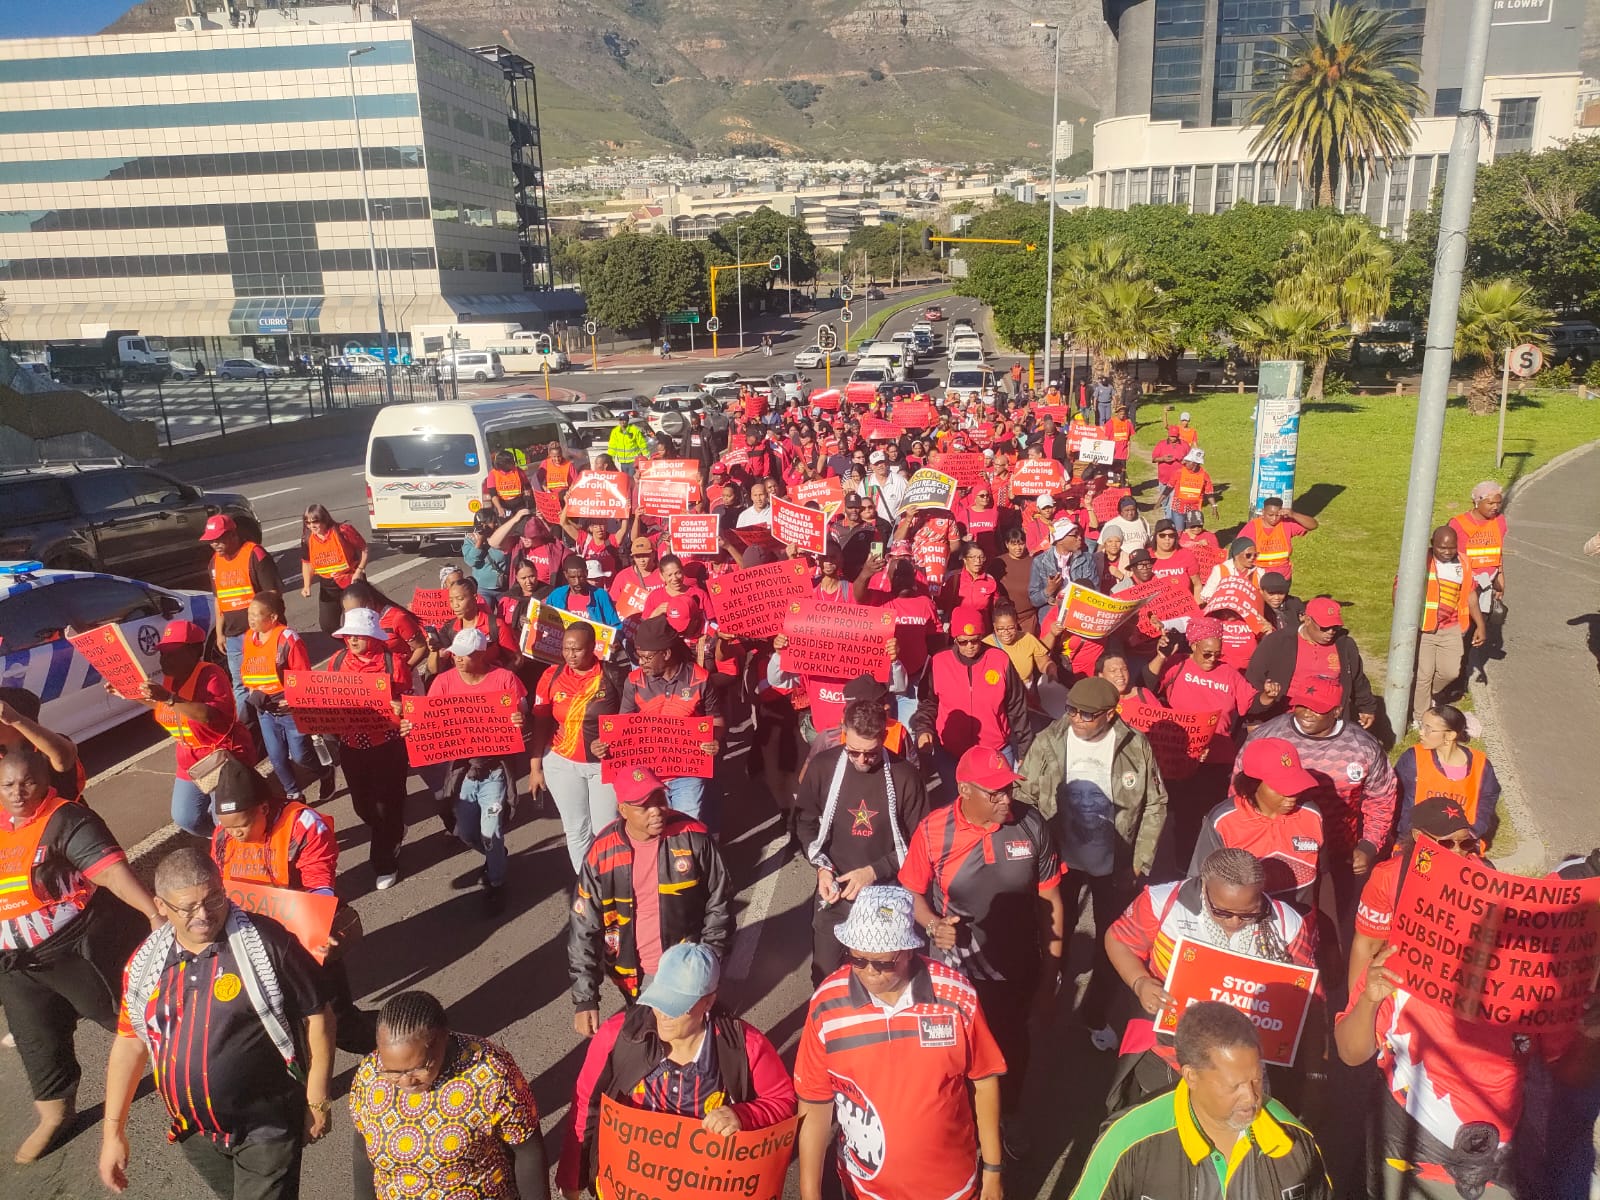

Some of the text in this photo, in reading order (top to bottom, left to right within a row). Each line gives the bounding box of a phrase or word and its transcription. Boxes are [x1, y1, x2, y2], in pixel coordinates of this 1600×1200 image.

[1507, 0, 1545, 9] LOWRY
[259, 318, 287, 326] CURRO
[1520, 352, 1533, 368] S
[581, 472, 617, 480] Labour
[797, 482, 828, 492] Labour
[1022, 487, 1051, 495] Slavery
[797, 489, 831, 500] Broking
[568, 498, 626, 509] Modern Day
[579, 507, 616, 518] Slavery
[780, 507, 811, 521] COSATU
[773, 516, 820, 536] DEPENDABLE
[778, 511, 814, 529] DEMANDS
[780, 526, 810, 540] ENERGY
[780, 532, 811, 547] SUPPLY!
[921, 545, 945, 553] bour
[924, 554, 945, 565] king
[733, 565, 783, 583] COMPANIES
[1152, 568, 1184, 577] ACTWU
[730, 576, 792, 596] MUST PROVIDE
[1130, 580, 1164, 596] COMPANIES
[1220, 576, 1256, 591] abour
[723, 597, 746, 611] SAFE,
[748, 589, 784, 607] RELIABLE
[786, 585, 804, 595] AND
[1087, 596, 1105, 606] COST
[719, 605, 765, 624] SUBSIDISED
[815, 603, 869, 617] COMPANIES
[1096, 611, 1122, 619] FIGHT
[727, 611, 786, 633] FOR EARLY AN
[807, 614, 873, 631] MUST PROVIDE
[895, 616, 927, 625] ACTWU
[1080, 622, 1093, 630] OR
[793, 626, 883, 644] SAFE, RELIABLE AND
[75, 636, 94, 649] ANIES
[787, 636, 834, 650] SUBSIDISED
[107, 654, 122, 665] AND
[788, 649, 883, 668] FOR EARLY AND LATE
[793, 661, 876, 677] WORKING HOURS
[311, 675, 363, 684] COMPANIES
[1184, 673, 1229, 693] SACTWU
[305, 687, 371, 696] MUST PROVIDE
[820, 688, 846, 701] SACT
[296, 698, 319, 706] SAFE,
[323, 698, 360, 706] RELIABLE
[429, 696, 486, 707] COMPANIES
[424, 706, 495, 719] MUST PROVIDE
[1138, 706, 1197, 723] COMPANIES
[414, 721, 440, 731] SAFE,
[444, 716, 483, 727] RELIABLE
[629, 716, 684, 726] COMPANIES
[408, 726, 518, 742] SUBSIDISED TRANSPORT
[622, 727, 692, 736] MUST PROVIDE
[416, 735, 514, 752] FOR EARLY AND LATE
[610, 738, 635, 748] SAFE,
[682, 739, 702, 748] AND
[1191, 735, 1209, 744] AND
[424, 745, 511, 761] WORKING HOURS
[611, 747, 706, 759] UBSIDISED TRANSPOR
[609, 759, 627, 769] FOR
[631, 756, 657, 766] EARLY
[667, 766, 699, 774] HOURS
[852, 829, 873, 837] SACP
[1459, 866, 1581, 905] COMPANIES
[229, 889, 297, 920] OSATU
[1439, 884, 1588, 930] MUST PROVIDE
[1414, 898, 1460, 936] SAFE,
[1469, 922, 1561, 955] RELIABLE
[1563, 931, 1597, 954] AND
[1397, 914, 1500, 971] SUBSIDISED
[1400, 941, 1434, 974] FOR
[1440, 962, 1504, 998] EARLY
[1511, 984, 1556, 1002] AND
[1223, 976, 1266, 995] STOP
[1210, 988, 1271, 1014] TAXING
[1406, 969, 1511, 1023] WORKING
[603, 1103, 795, 1162] Signed Collective
[626, 1149, 760, 1197] Bargaining
